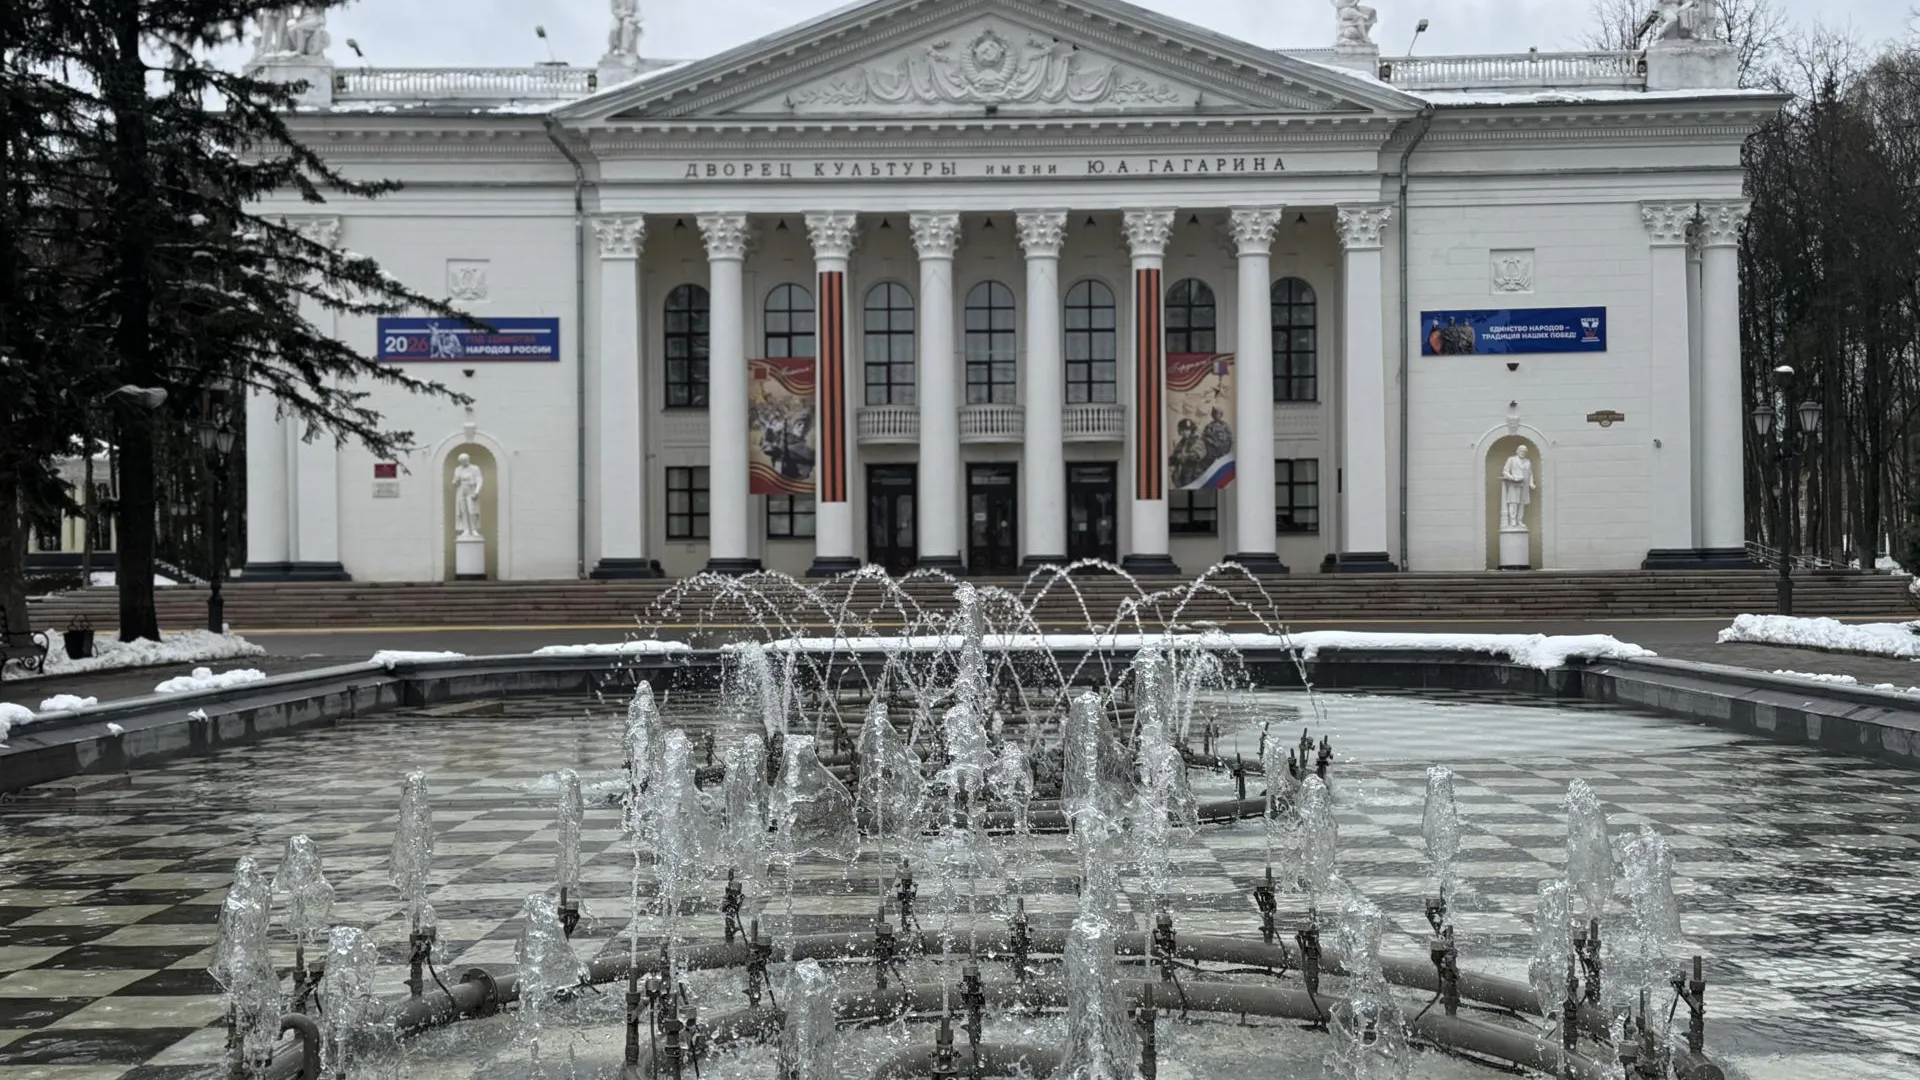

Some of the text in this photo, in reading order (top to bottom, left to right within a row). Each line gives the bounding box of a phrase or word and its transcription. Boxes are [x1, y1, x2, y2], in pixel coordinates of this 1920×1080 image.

[685, 163, 792, 178] ДВОРЕЦ
[814, 162, 956, 176] КУЛЬТУРЫ
[1489, 325, 1528, 333] ЕДИНСТВО
[1529, 324, 1564, 332] НАРОДОВ
[1522, 332, 1549, 340] НАШИХ
[1550, 332, 1577, 340] ПОБЕД!
[385, 336, 430, 353] 2026
[466, 345, 552, 355] НАРОДОВ РОССИИ
